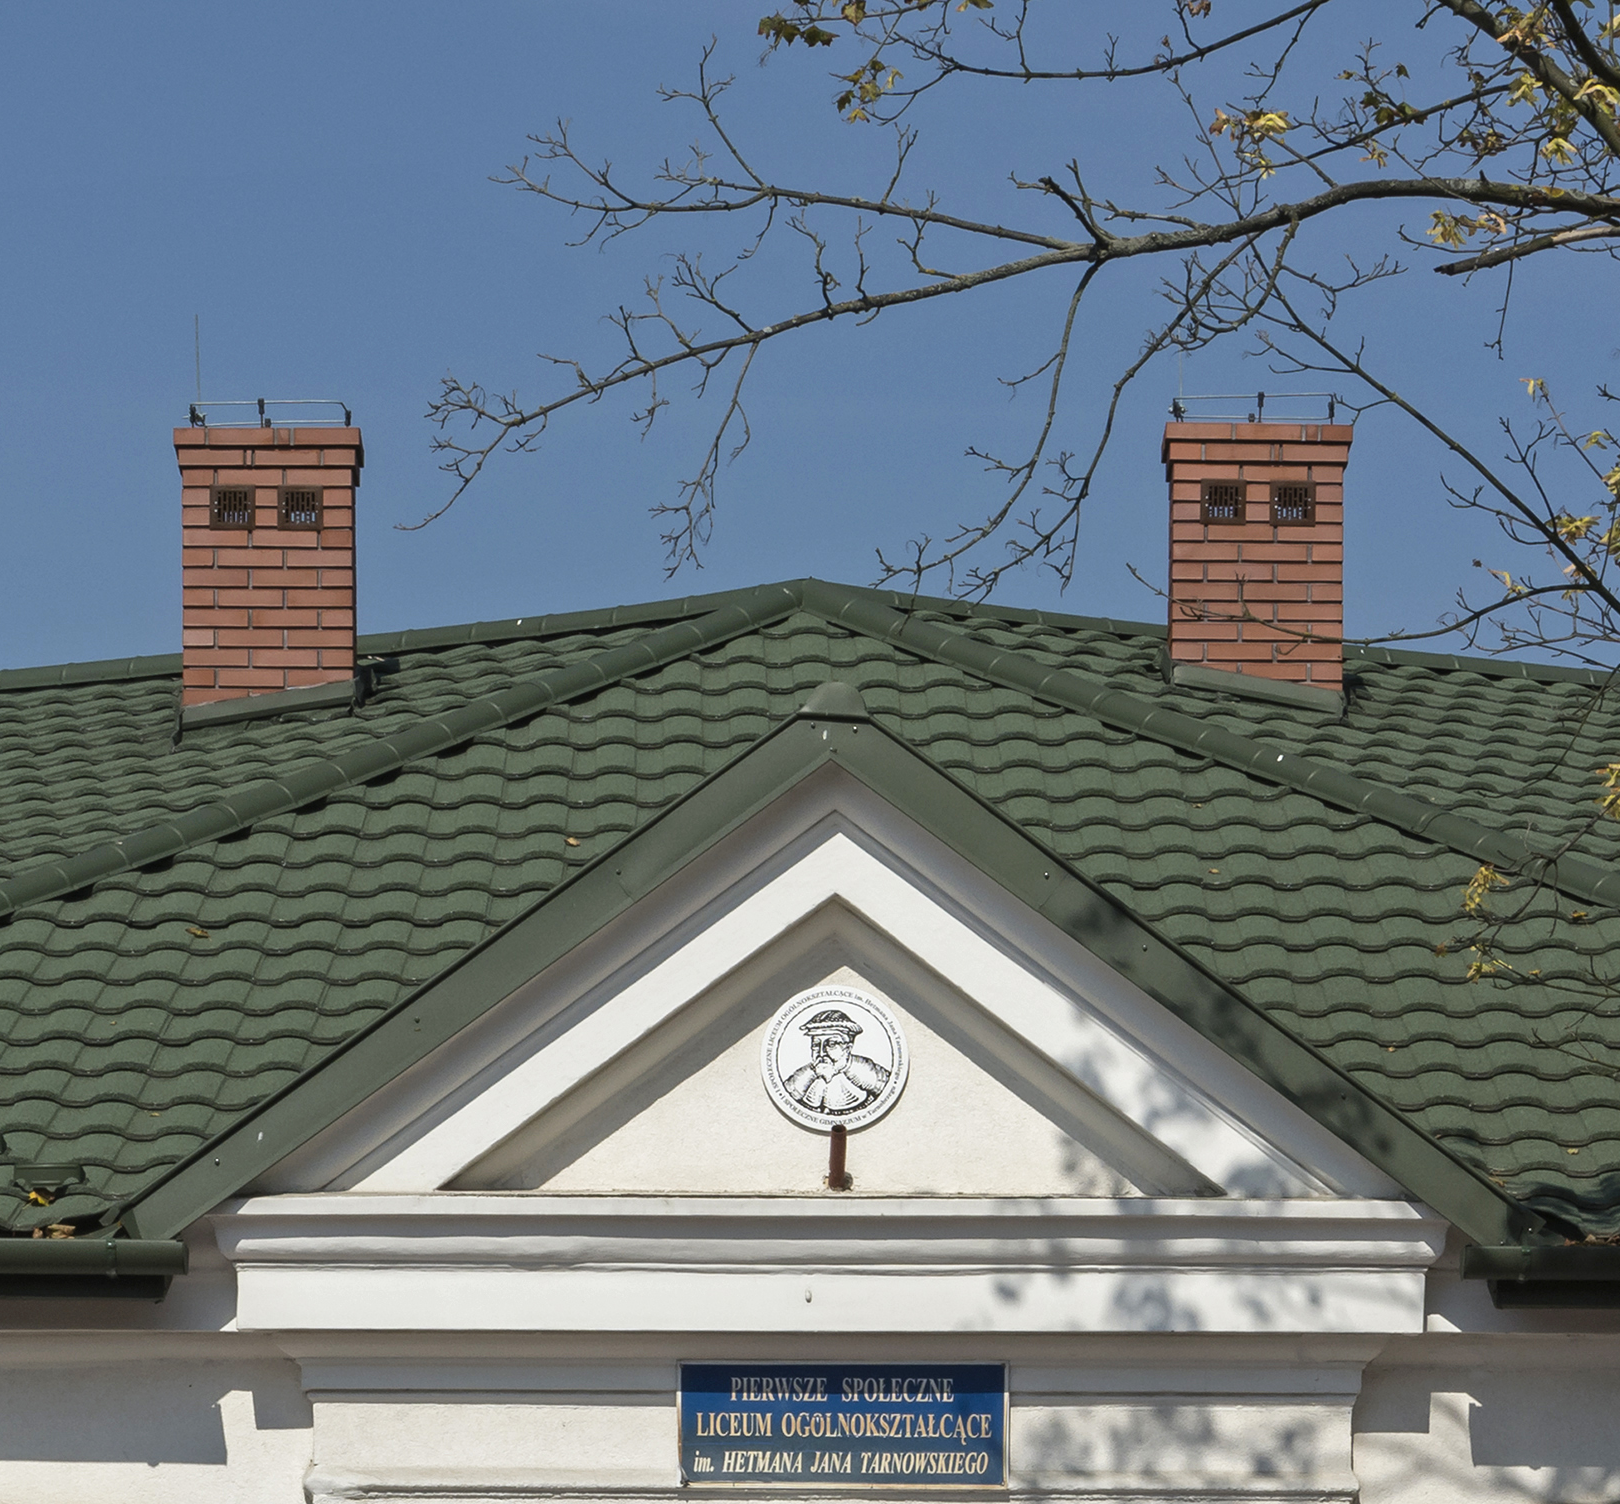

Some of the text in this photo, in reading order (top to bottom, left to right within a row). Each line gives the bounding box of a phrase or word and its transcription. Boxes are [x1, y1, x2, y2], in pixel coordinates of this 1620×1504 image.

[768, 1019, 783, 1047] LICEUM
[729, 1376, 954, 1403] PIERWSZE SPOŁECZNE
[696, 1411, 993, 1445] LICEUM OGÓLNOKSZTAŁCĄCE
[693, 1451, 989, 1475] im. HETMANA JANA TARNOWSKIEGO
